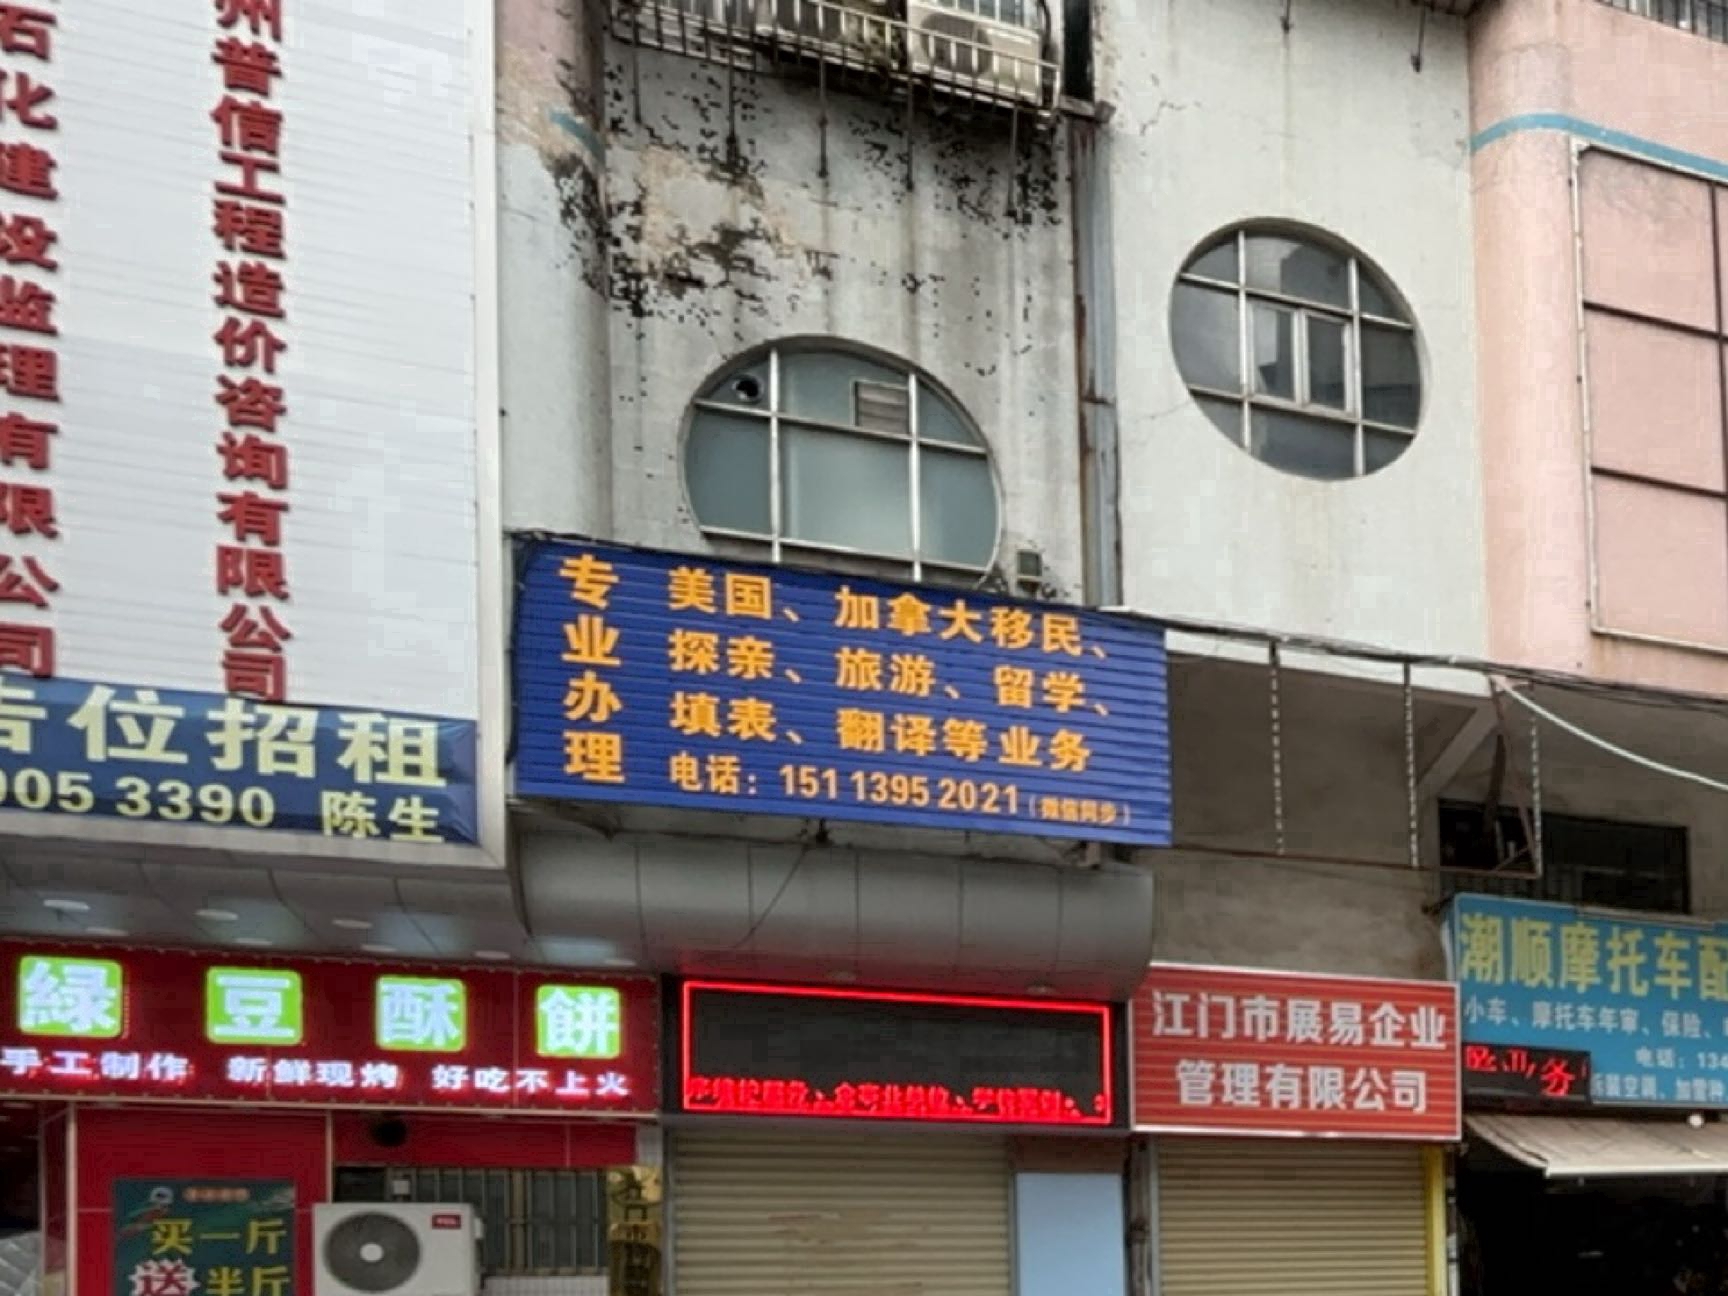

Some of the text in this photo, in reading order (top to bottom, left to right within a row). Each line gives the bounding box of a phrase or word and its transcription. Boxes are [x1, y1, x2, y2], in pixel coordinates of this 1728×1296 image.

[211, 0, 290, 700] 州普信工程造价咨询有限公司
[668, 566, 1108, 659] 美国、加拿大移民、
[559, 554, 624, 784] 专业办理
[668, 629, 1110, 716] 探亲、旅游、留学、
[668, 691, 1092, 772] 填表、翻译等业务
[0, 767, 446, 844] 05 3390 陈生
[779, 764, 838, 800] 151
[852, 771, 929, 807] 1395
[938, 778, 1019, 813] 2021
[1153, 990, 1446, 1051] 江门市展易企业
[0, 1048, 631, 1096] 手工制作 新鲜现烤 好吃不上火
[1177, 1059, 1427, 1113] 管理有限公司
[152, 1217, 288, 1256] 买一斤
